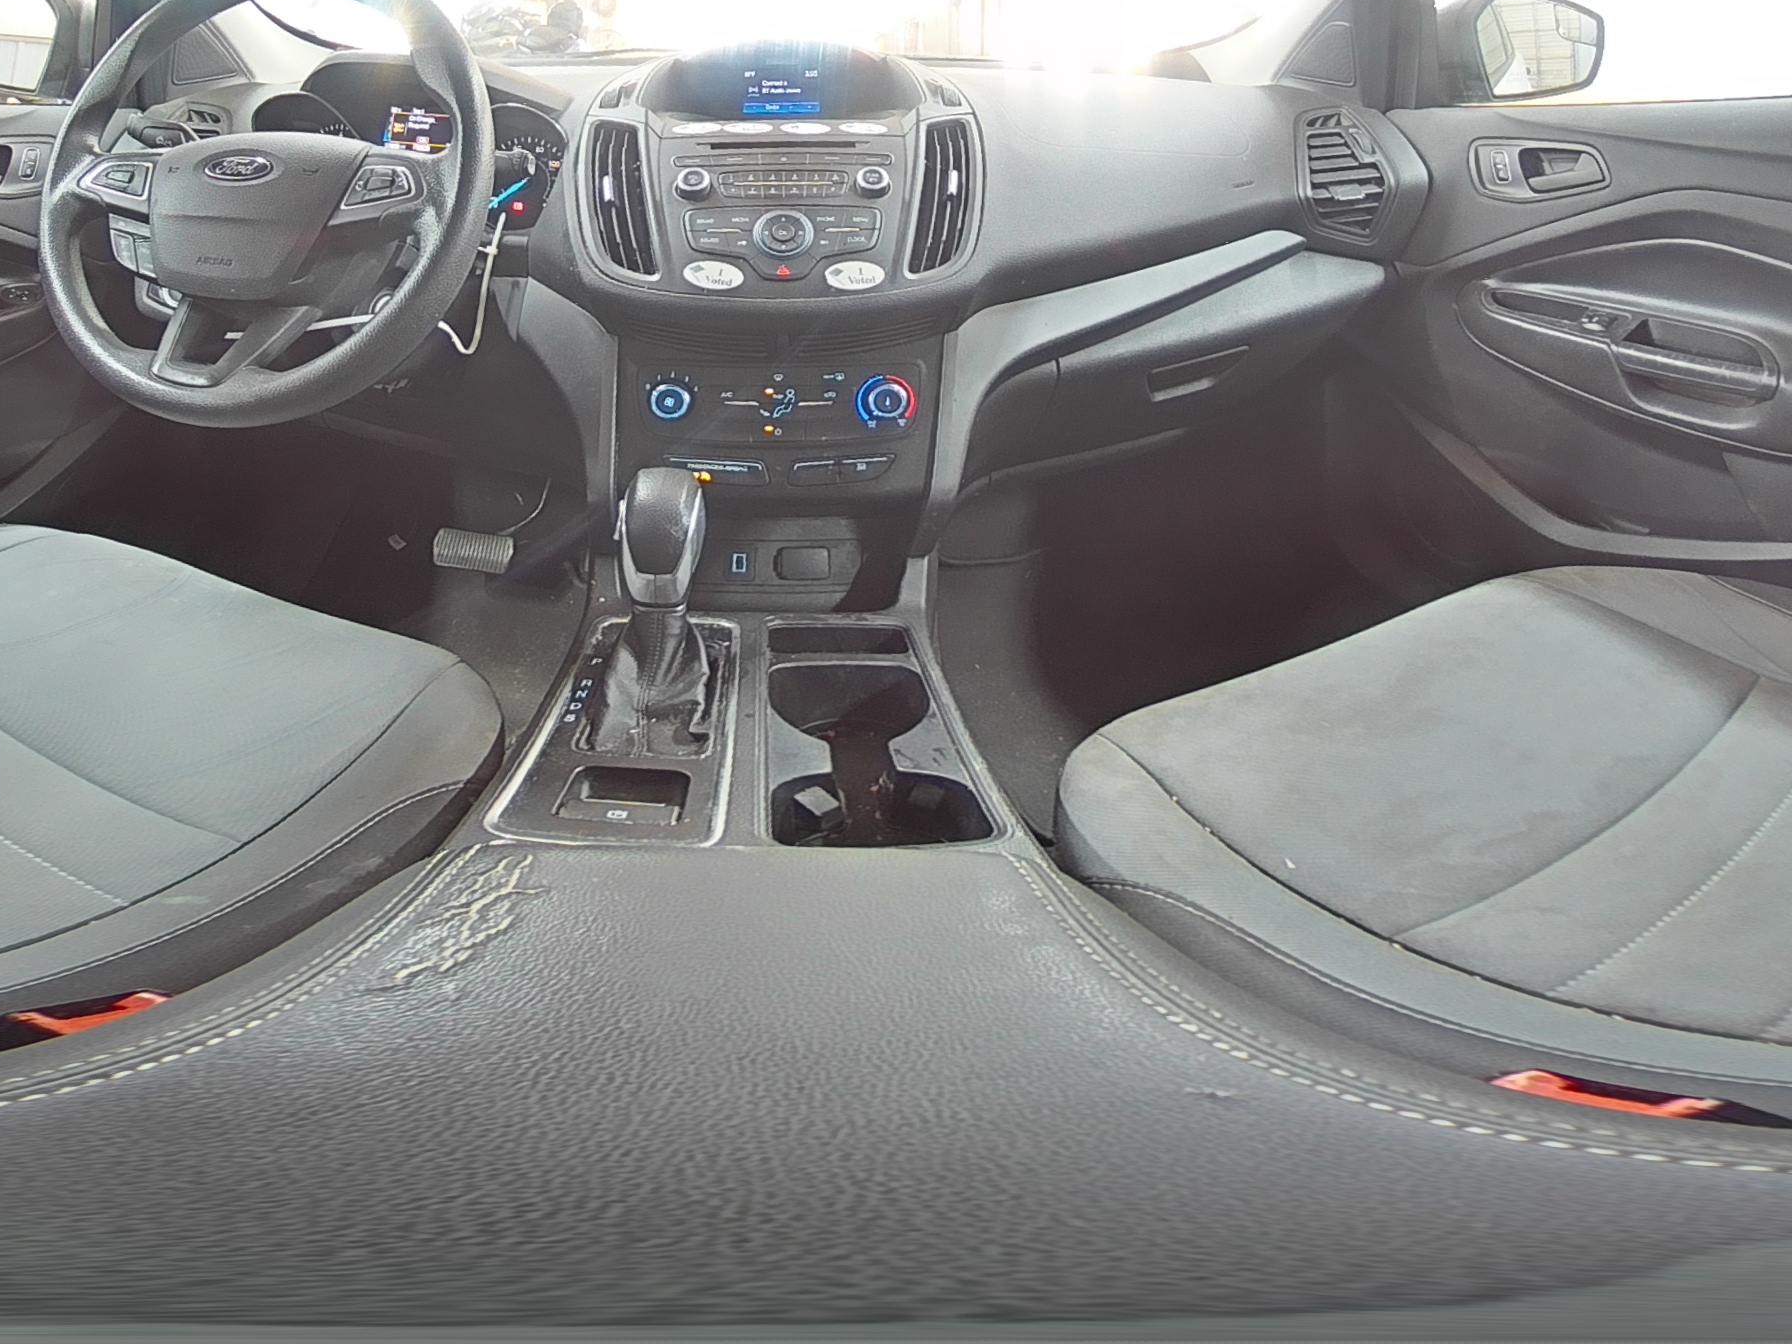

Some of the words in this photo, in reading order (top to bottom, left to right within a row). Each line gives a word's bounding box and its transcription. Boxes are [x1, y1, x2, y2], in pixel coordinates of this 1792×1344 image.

[215, 158, 258, 174] Ford
[705, 275, 733, 287] Voted
[848, 274, 876, 286] Voted
[591, 658, 603, 666] P
[580, 679, 593, 687] R
[575, 689, 589, 699] N
[569, 702, 583, 710] D
[563, 714, 577, 723] S
